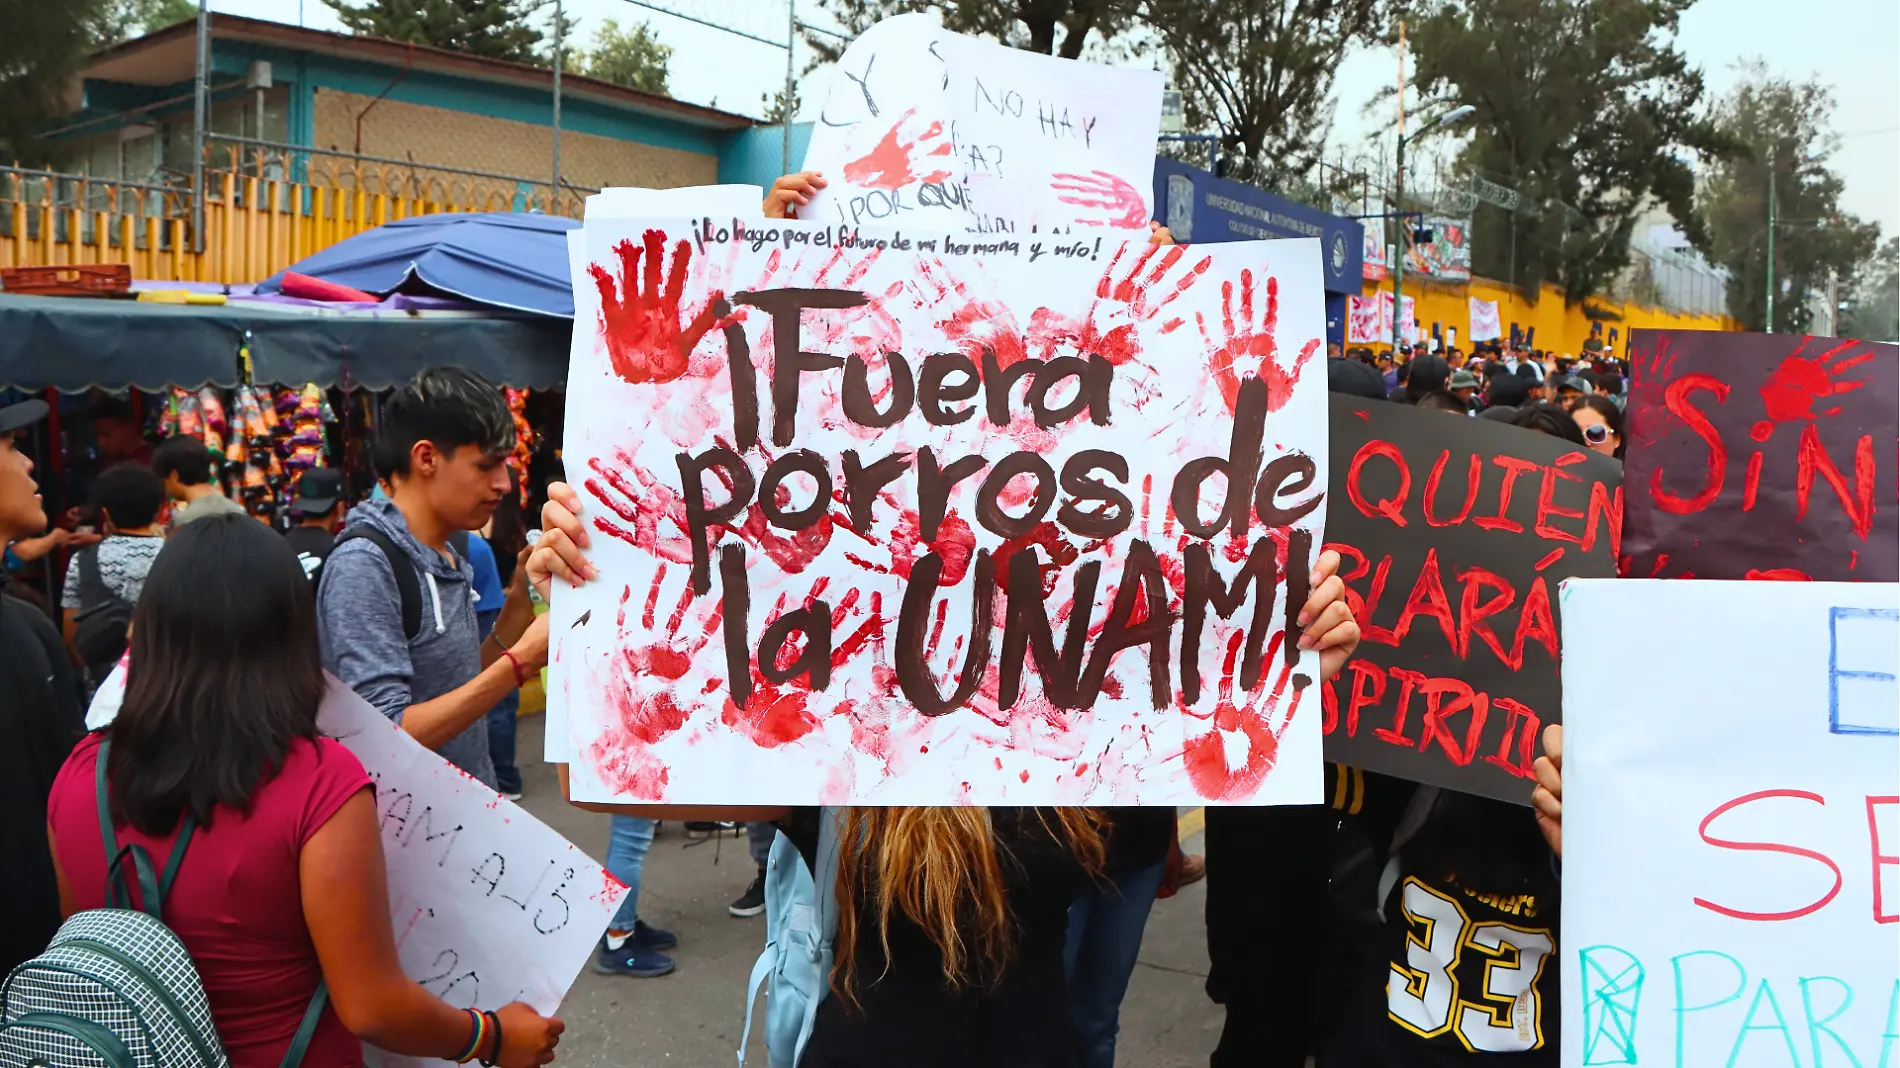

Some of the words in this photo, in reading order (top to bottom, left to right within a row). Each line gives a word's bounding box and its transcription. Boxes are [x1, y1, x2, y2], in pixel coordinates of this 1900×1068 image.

[975, 76, 1024, 118] NO
[1037, 98, 1097, 150] HAY
[691, 217, 729, 255] ¡Lo
[732, 217, 780, 252] hago
[783, 229, 809, 249] por
[813, 226, 831, 248] el
[838, 224, 888, 250] futuro
[891, 231, 912, 251] de
[917, 239, 938, 253] mi
[944, 235, 1020, 257] hermana
[1029, 242, 1047, 263] y
[713, 288, 1114, 452] ¡Fuera
[675, 447, 1134, 597] porros
[1170, 376, 1325, 540] de
[1347, 439, 1624, 560] QUIÉN
[718, 540, 832, 709] la
[895, 529, 1314, 717] UNAM!
[1386, 875, 1556, 1053] 33
